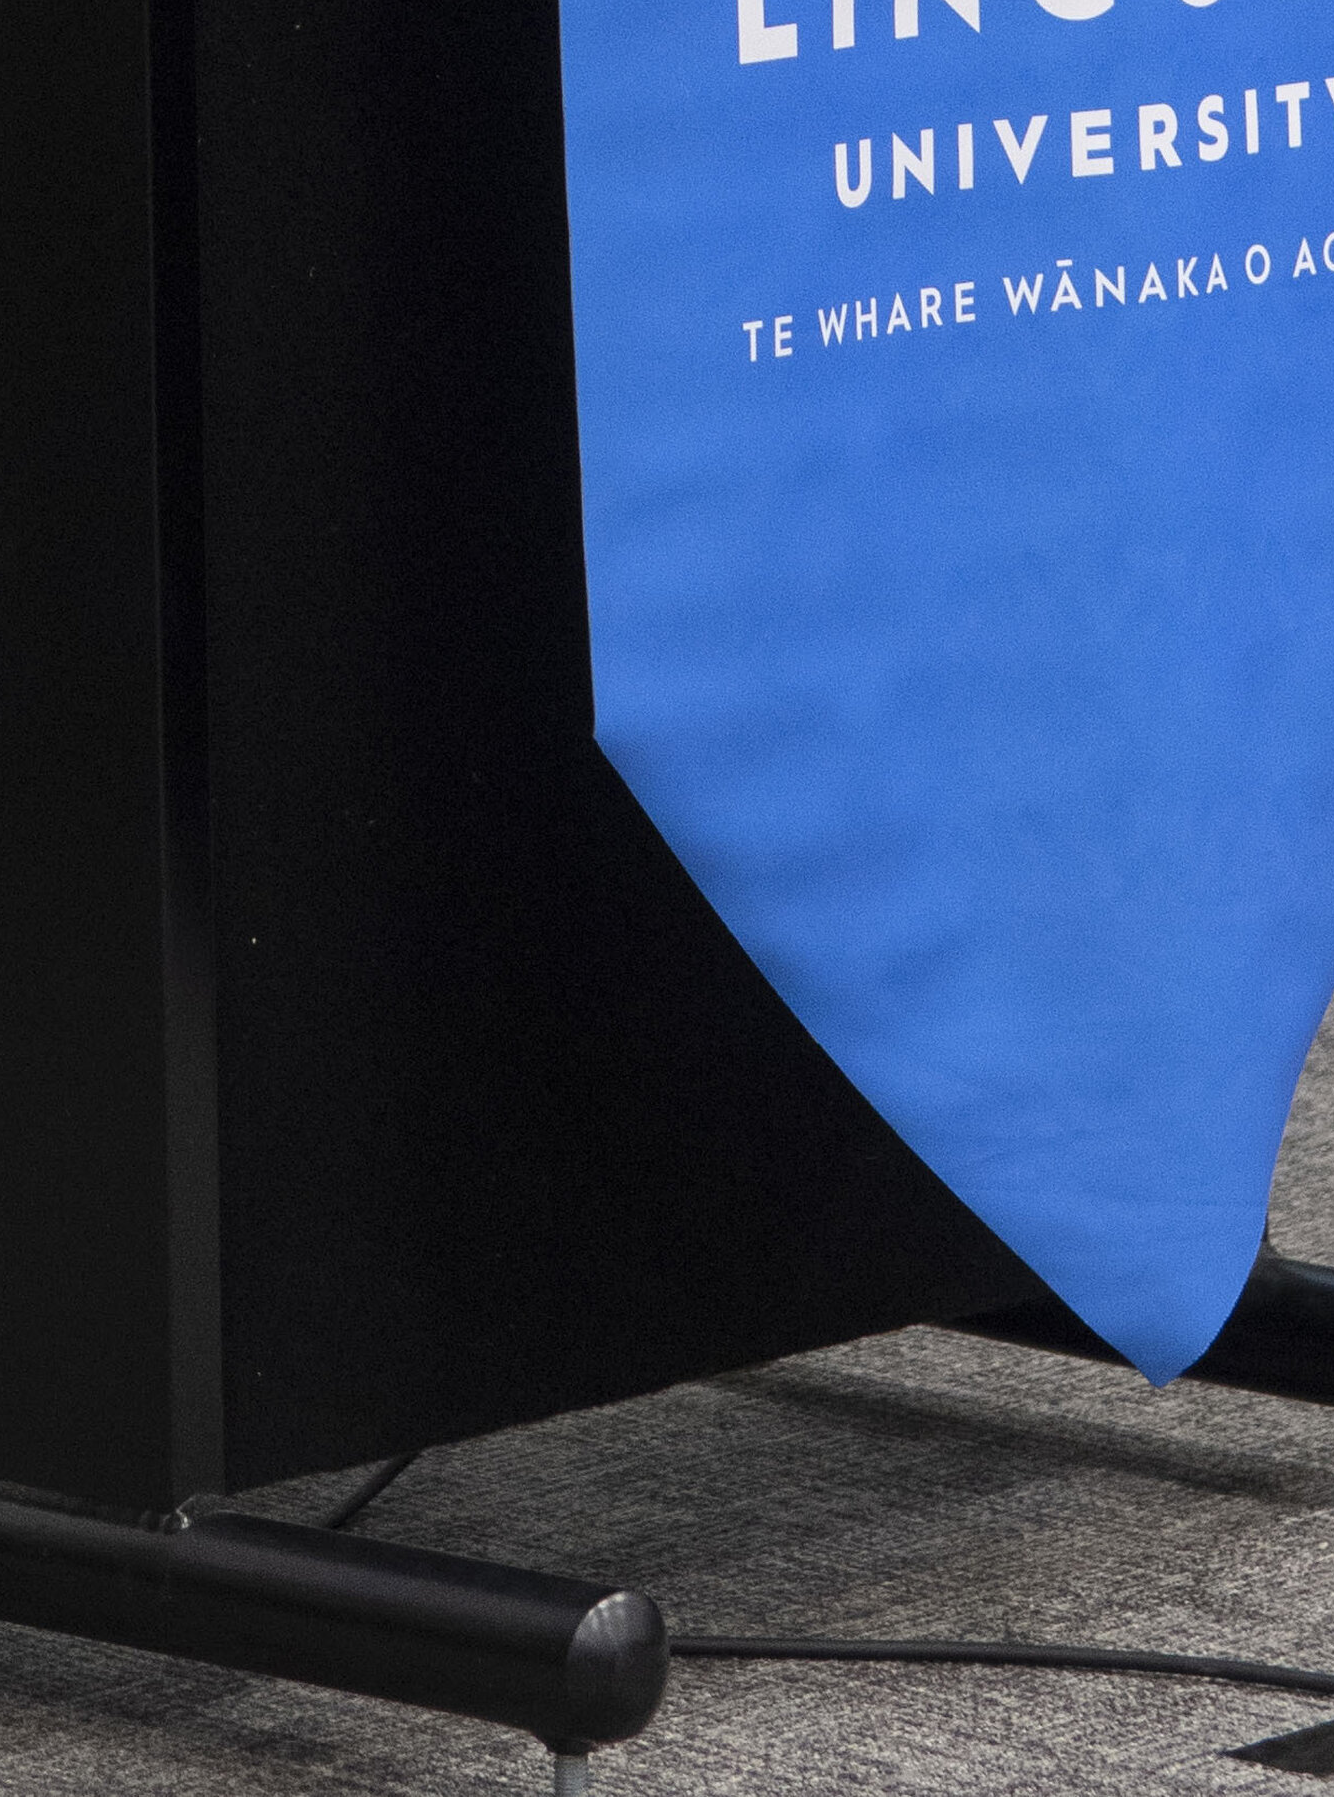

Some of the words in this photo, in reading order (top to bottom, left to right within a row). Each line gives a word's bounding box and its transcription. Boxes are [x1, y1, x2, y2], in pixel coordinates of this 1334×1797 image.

[742, 315, 794, 362] TE
[817, 281, 976, 347] WHARE
[1002, 252, 1229, 316] WĀNAKA
[1244, 244, 1271, 285] O
